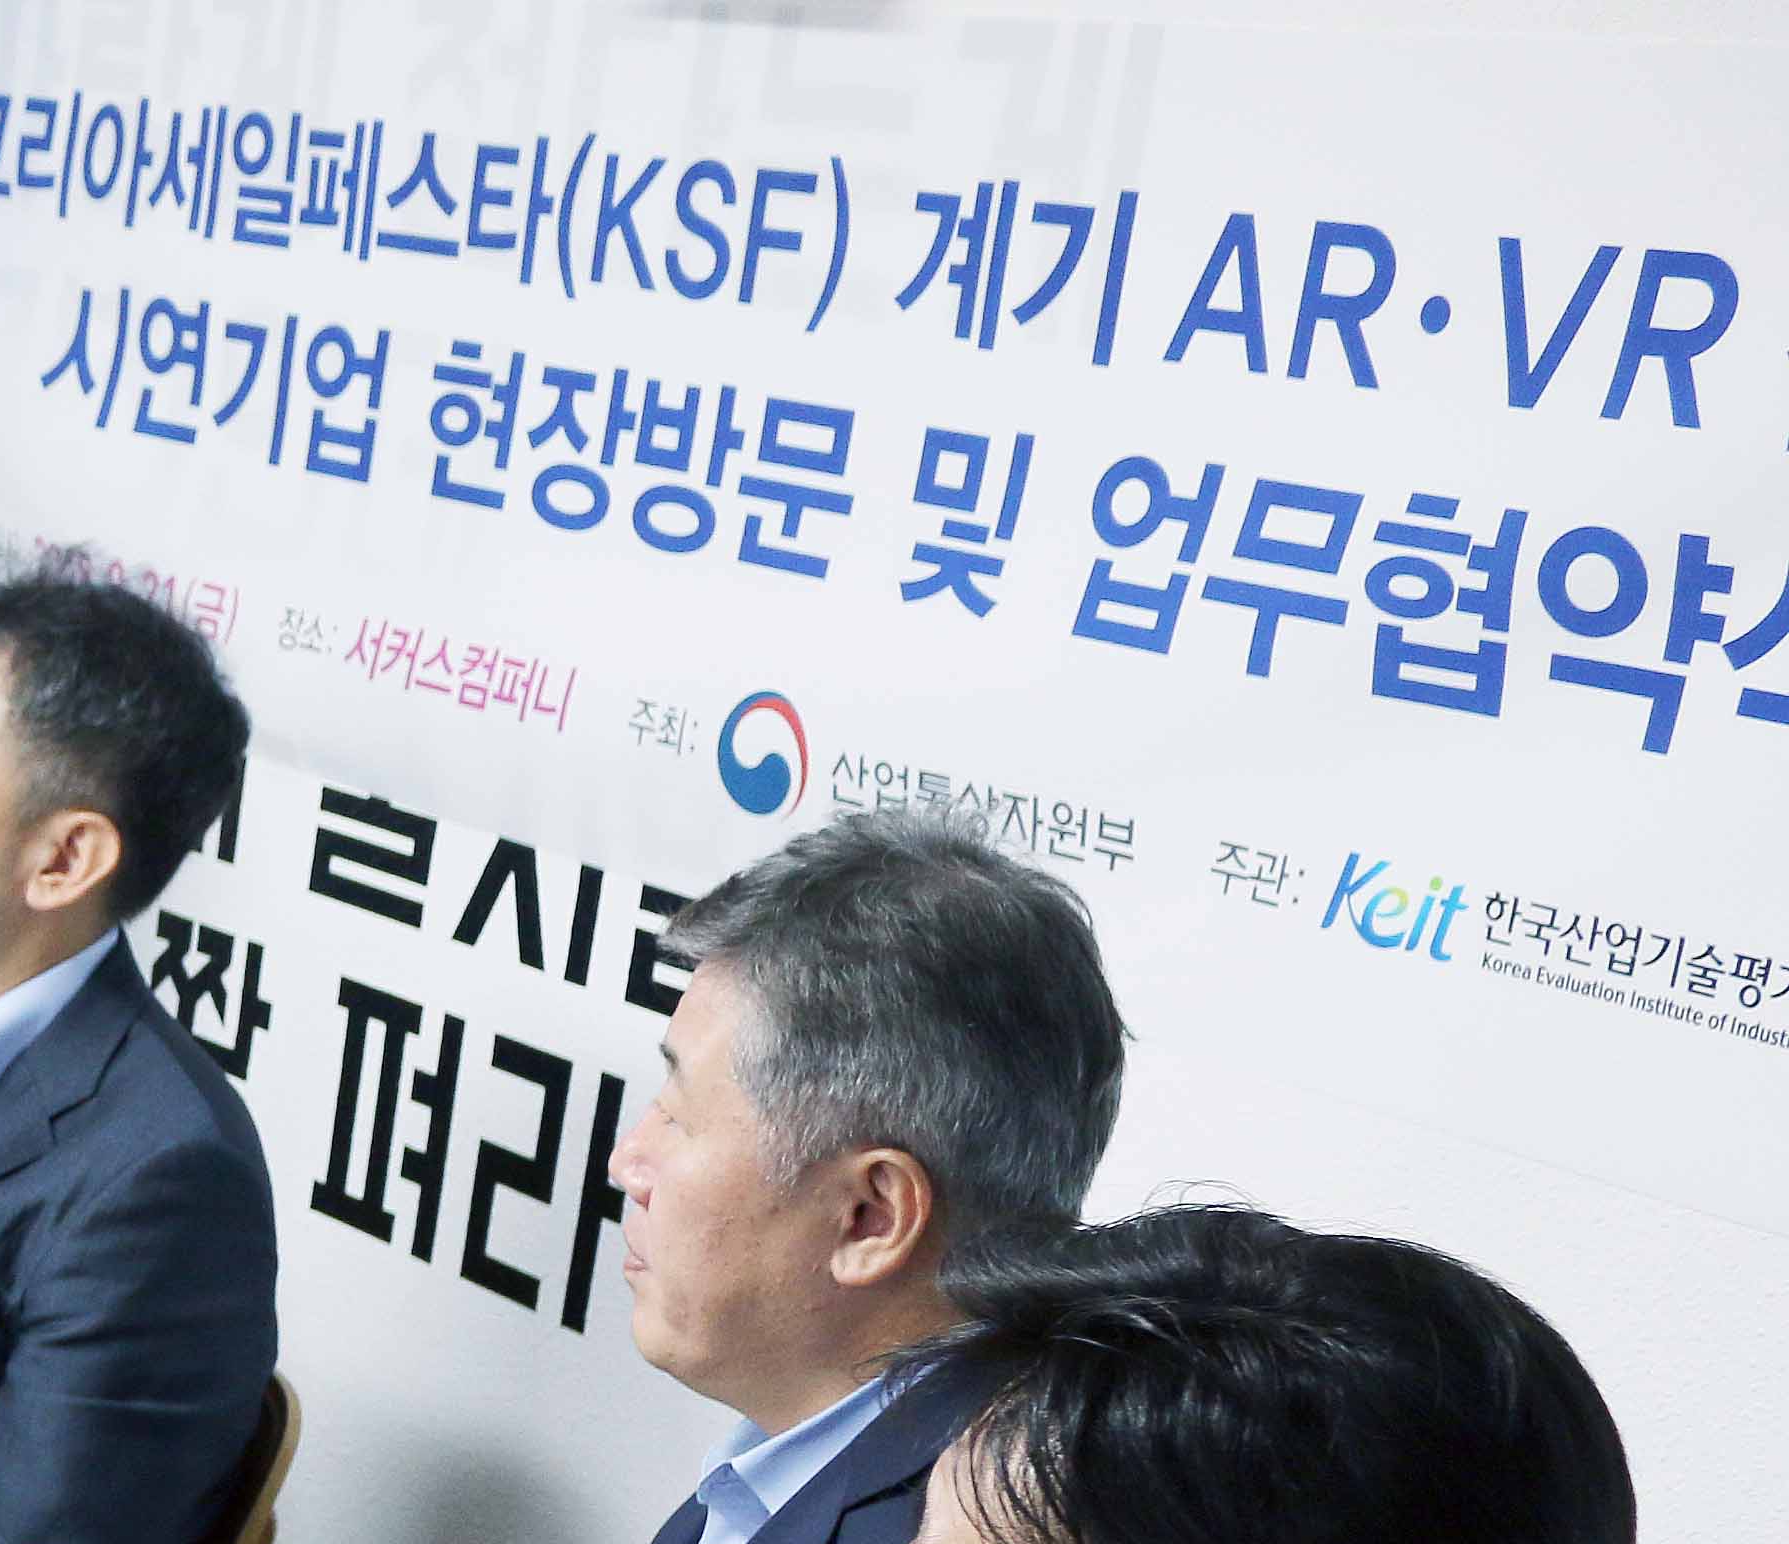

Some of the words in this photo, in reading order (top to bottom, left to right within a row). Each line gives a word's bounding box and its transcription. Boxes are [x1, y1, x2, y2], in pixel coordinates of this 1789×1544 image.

[894, 179, 1139, 367] 계기
[40, 287, 390, 483] 시연기업
[429, 339, 856, 578] 현장방문
[900, 427, 1035, 618] 및
[277, 606, 338, 655] 장소:
[344, 615, 577, 733] 서커스컴퍼니
[628, 699, 699, 756] 주최:
[1210, 841, 1305, 907] 주관:
[1320, 850, 1469, 961] Keit
[1481, 952, 1532, 982] Korea
[1536, 965, 1625, 1006] Evaluation
[1629, 988, 1704, 1027] Institute
[1708, 1013, 1727, 1033] of
[310, 975, 627, 1337] 펴라
